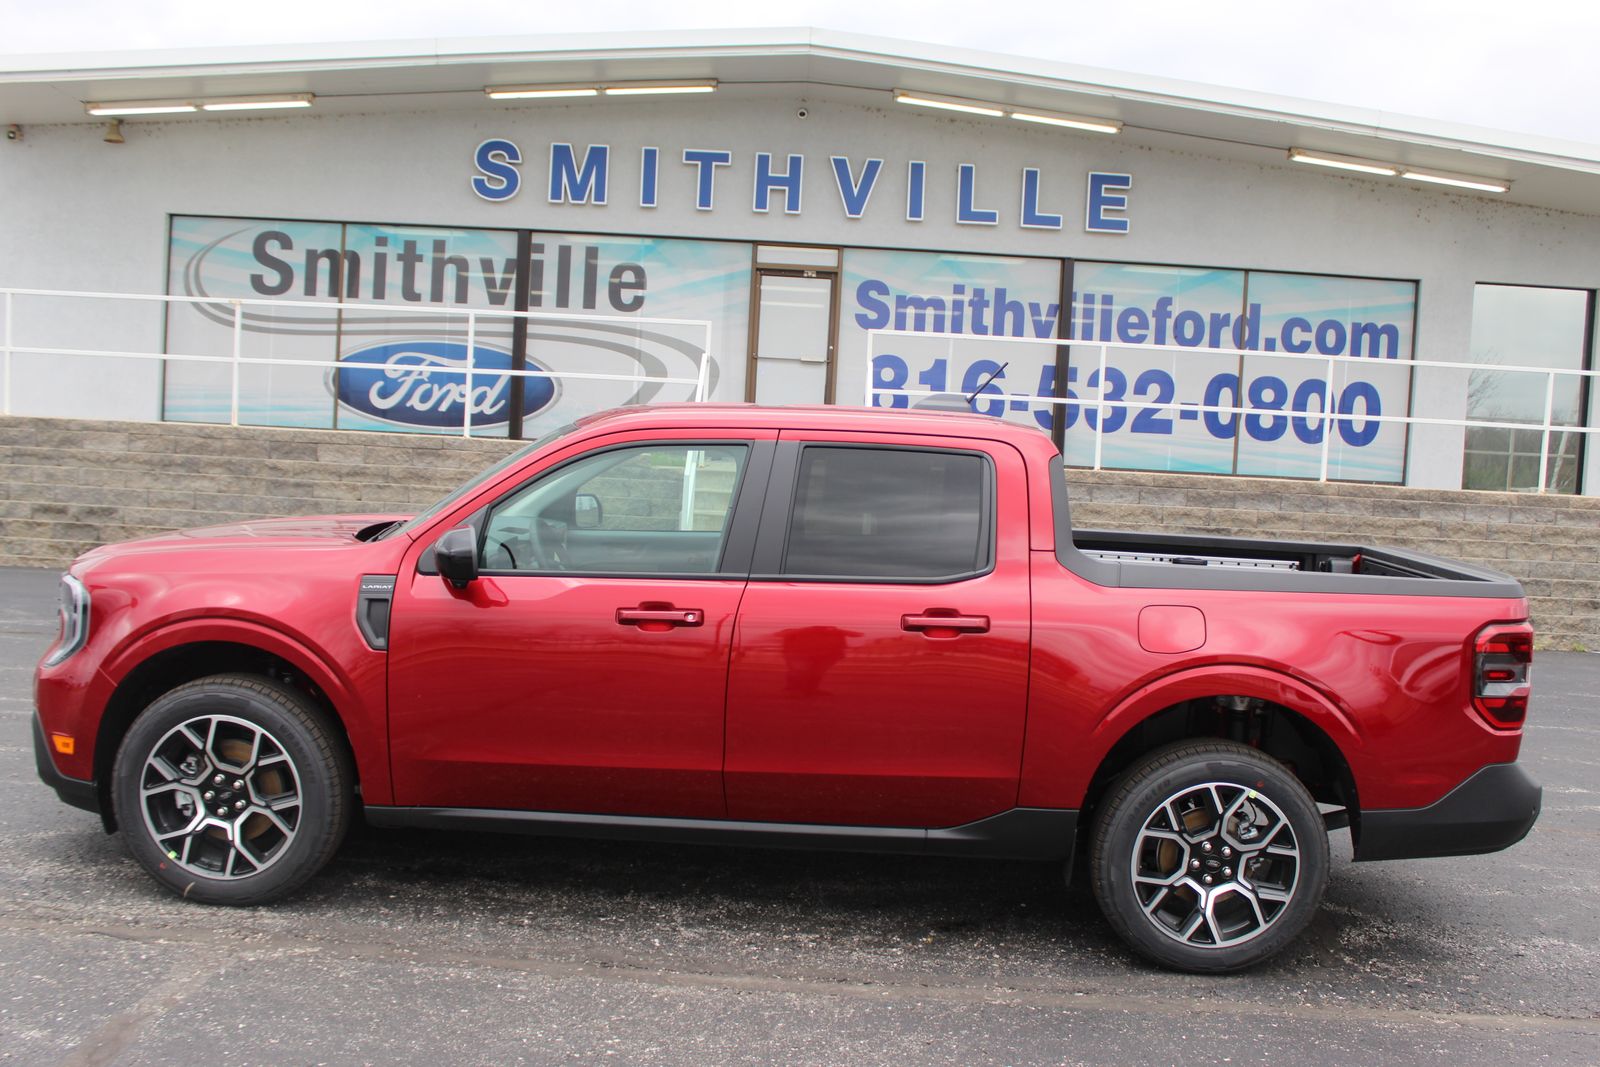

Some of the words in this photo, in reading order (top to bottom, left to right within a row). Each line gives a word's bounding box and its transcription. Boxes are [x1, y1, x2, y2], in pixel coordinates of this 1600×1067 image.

[471, 137, 1133, 234] SMITHVILLE
[249, 230, 648, 313] Smithville
[368, 351, 506, 416] Ford
[871, 353, 1382, 448] 816-532-0800
